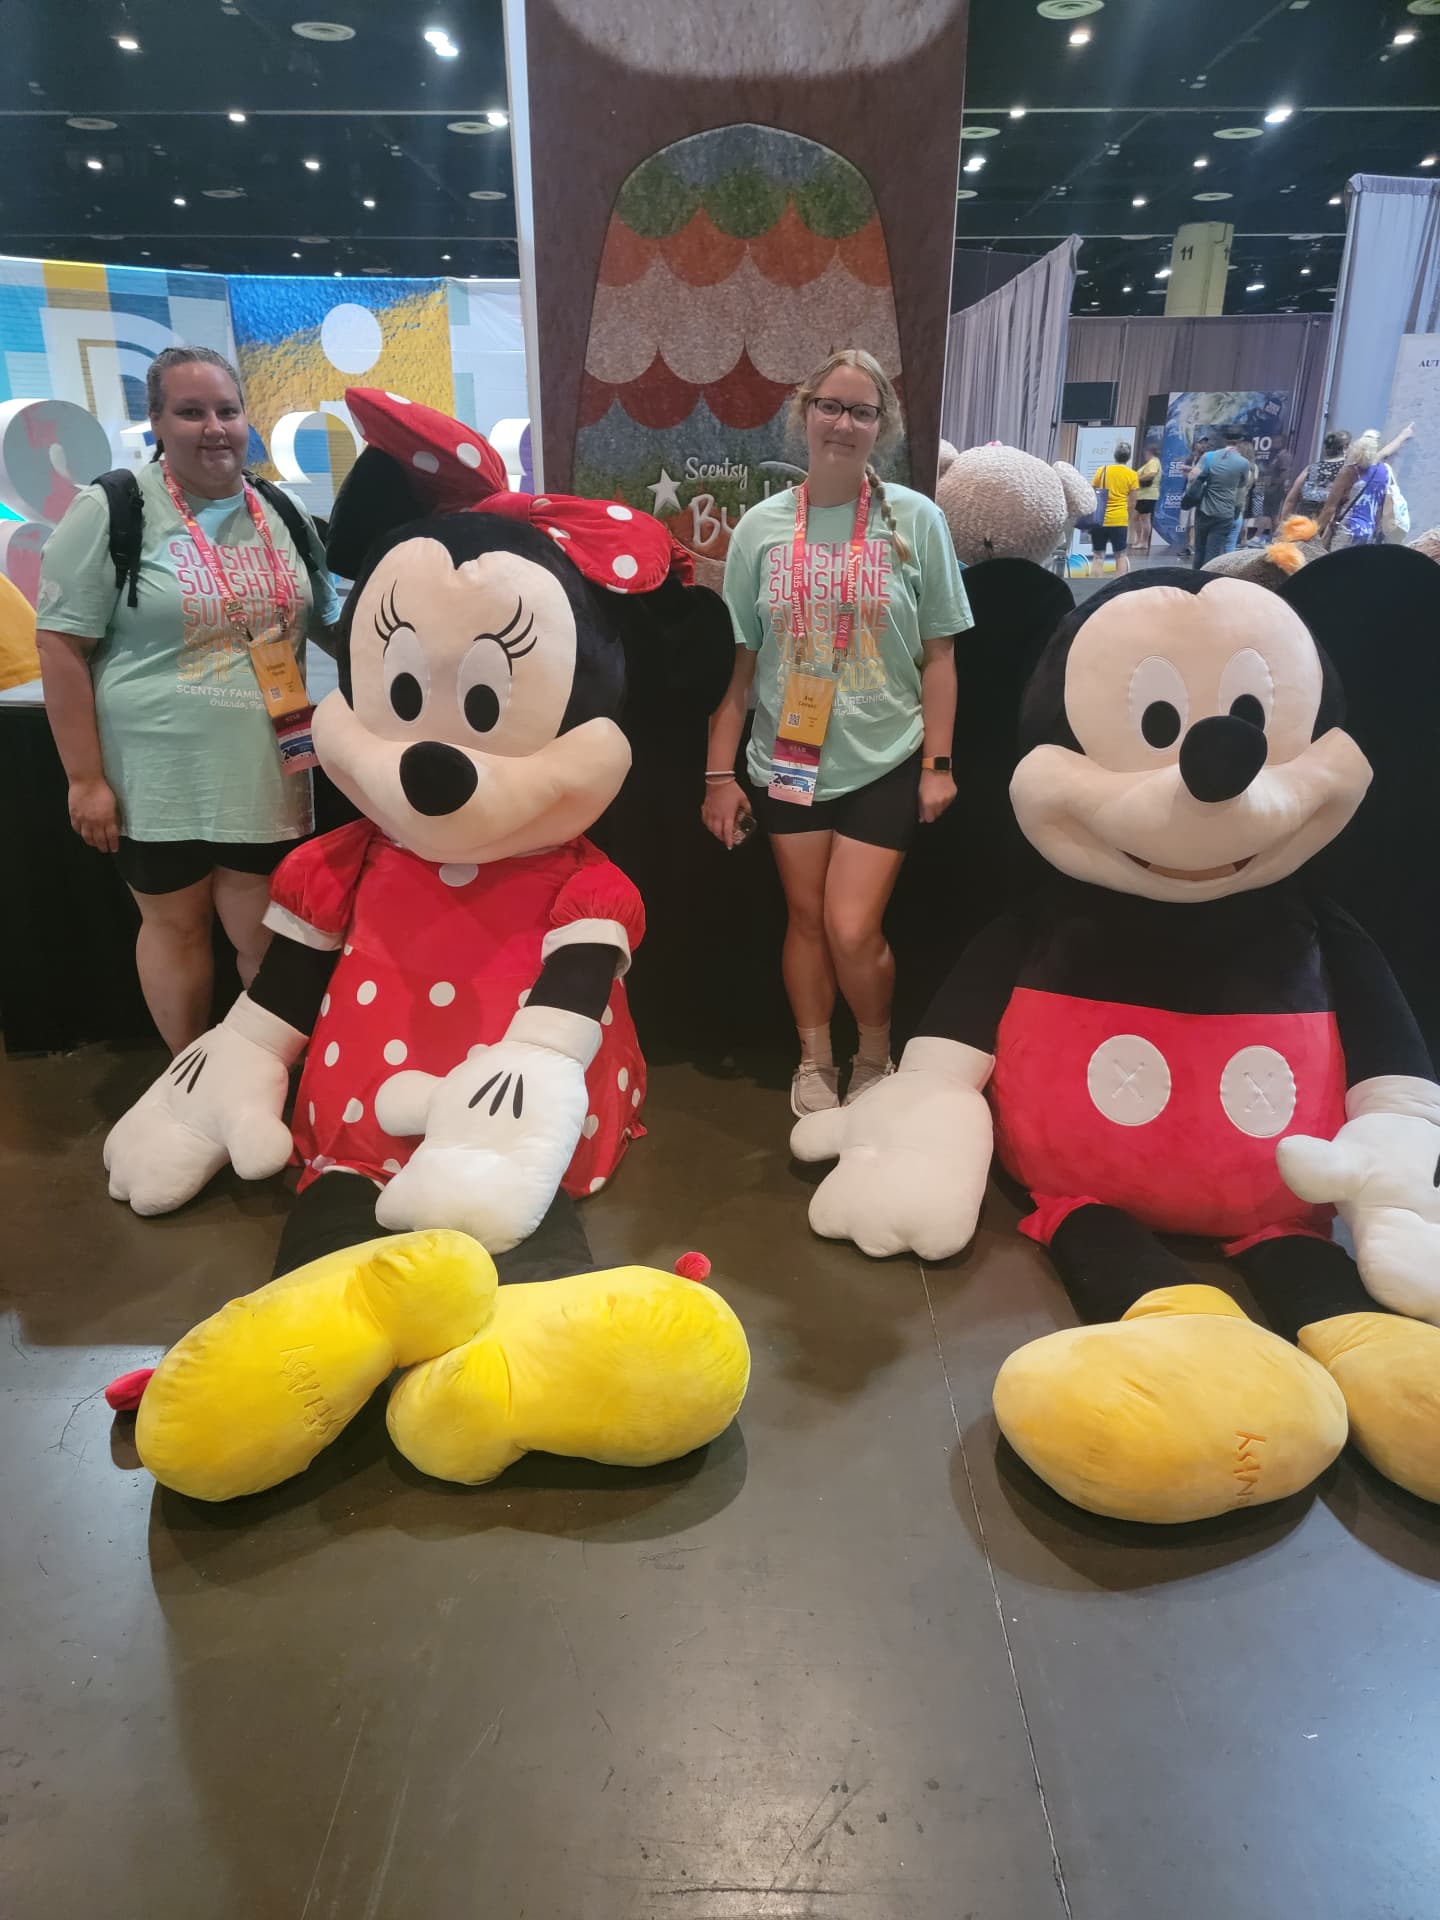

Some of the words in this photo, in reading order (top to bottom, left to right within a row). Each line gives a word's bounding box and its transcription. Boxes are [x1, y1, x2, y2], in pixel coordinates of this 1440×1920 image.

[1180, 245, 1194, 261] 11
[1252, 436, 1272, 451] 10
[686, 457, 748, 489] Scentsy
[169, 541, 296, 573] SUSHIE
[769, 541, 891, 575] SUNSHNE
[177, 569, 304, 600] SUSHIE
[769, 569, 891, 604] SUNSHNE
[769, 599, 890, 634] SUNSNE
[175, 684, 226, 697] SCENTSY
